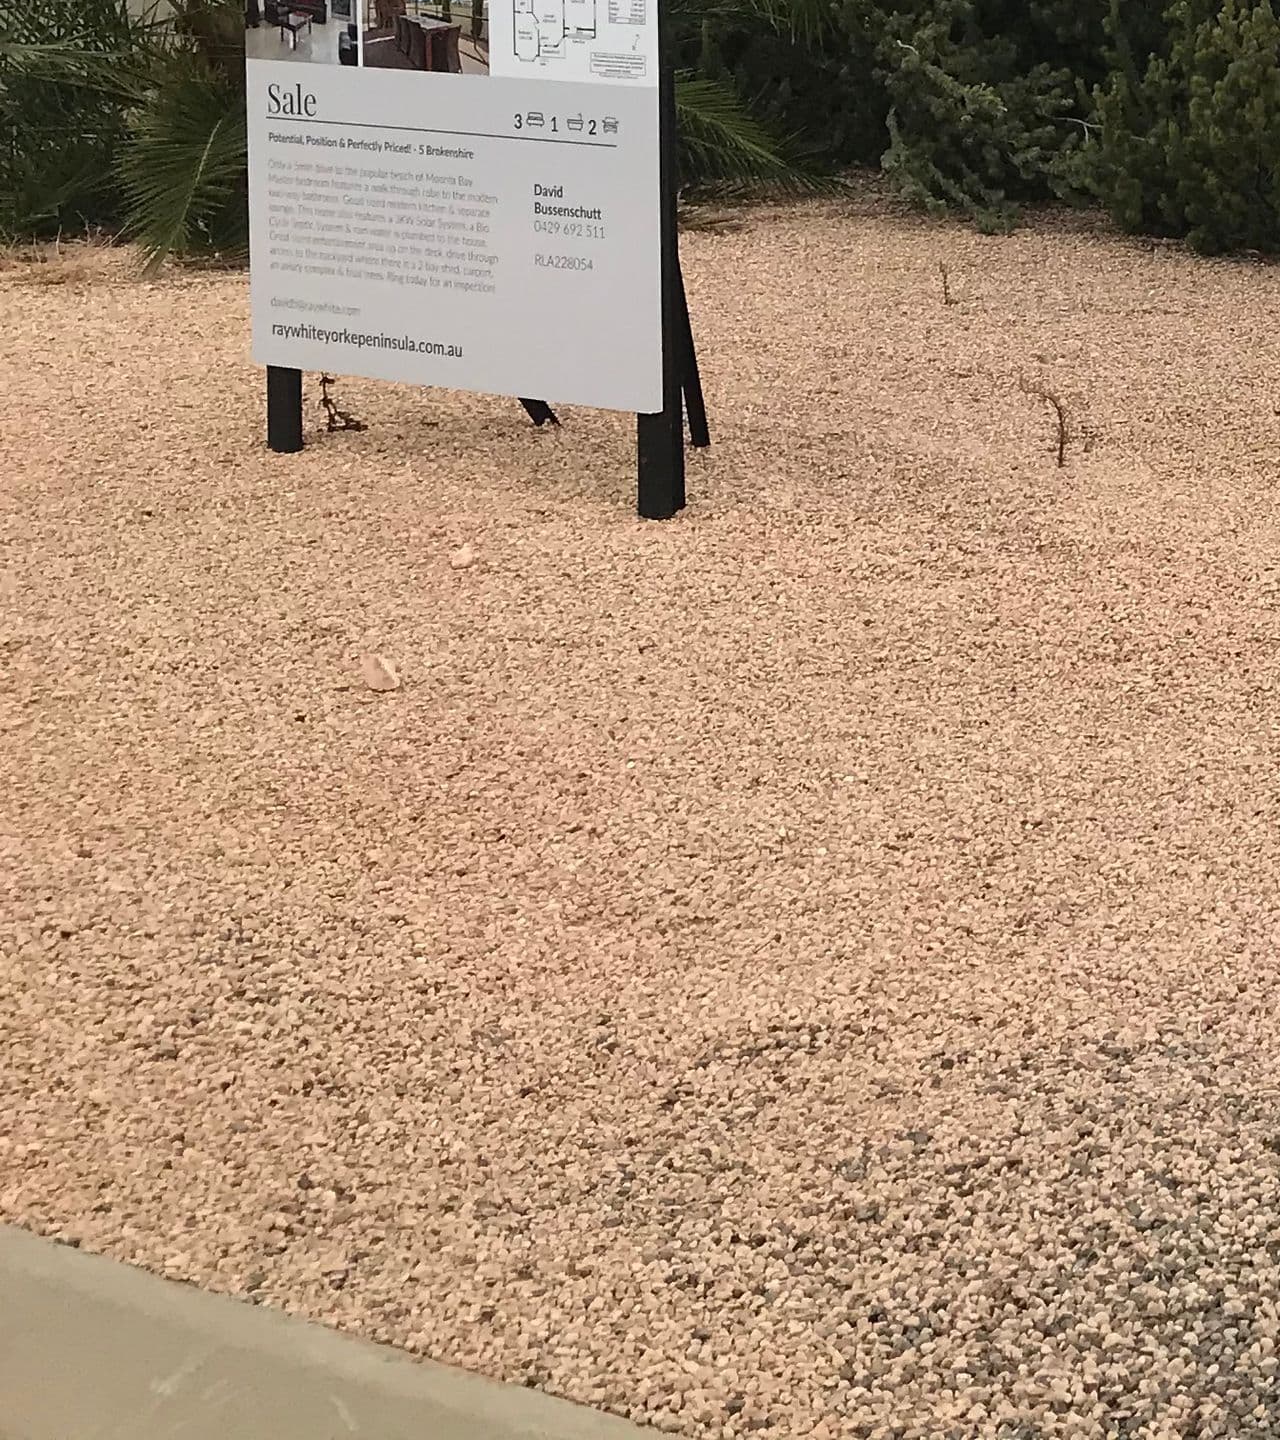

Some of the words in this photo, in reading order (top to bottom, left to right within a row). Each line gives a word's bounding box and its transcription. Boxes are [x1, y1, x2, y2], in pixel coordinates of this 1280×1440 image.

[267, 83, 317, 117] Sale
[514, 113, 523, 129] 3
[551, 116, 559, 132] 1
[588, 119, 597, 135] 2
[268, 132, 305, 145] Potential,
[306, 135, 337, 147] Position
[339, 138, 346, 148] &
[347, 139, 382, 152] Perfectly
[384, 141, 412, 154] Priced!
[419, 145, 425, 155] 5
[426, 145, 474, 160] Brokenshire
[458, 176, 472, 188] Bay
[534, 184, 563, 198] David
[534, 202, 602, 220] Bussenschutt
[563, 223, 583, 237] 692
[586, 225, 605, 239] 511
[272, 322, 463, 358] raywhiteyorkepeninsula.com.au
